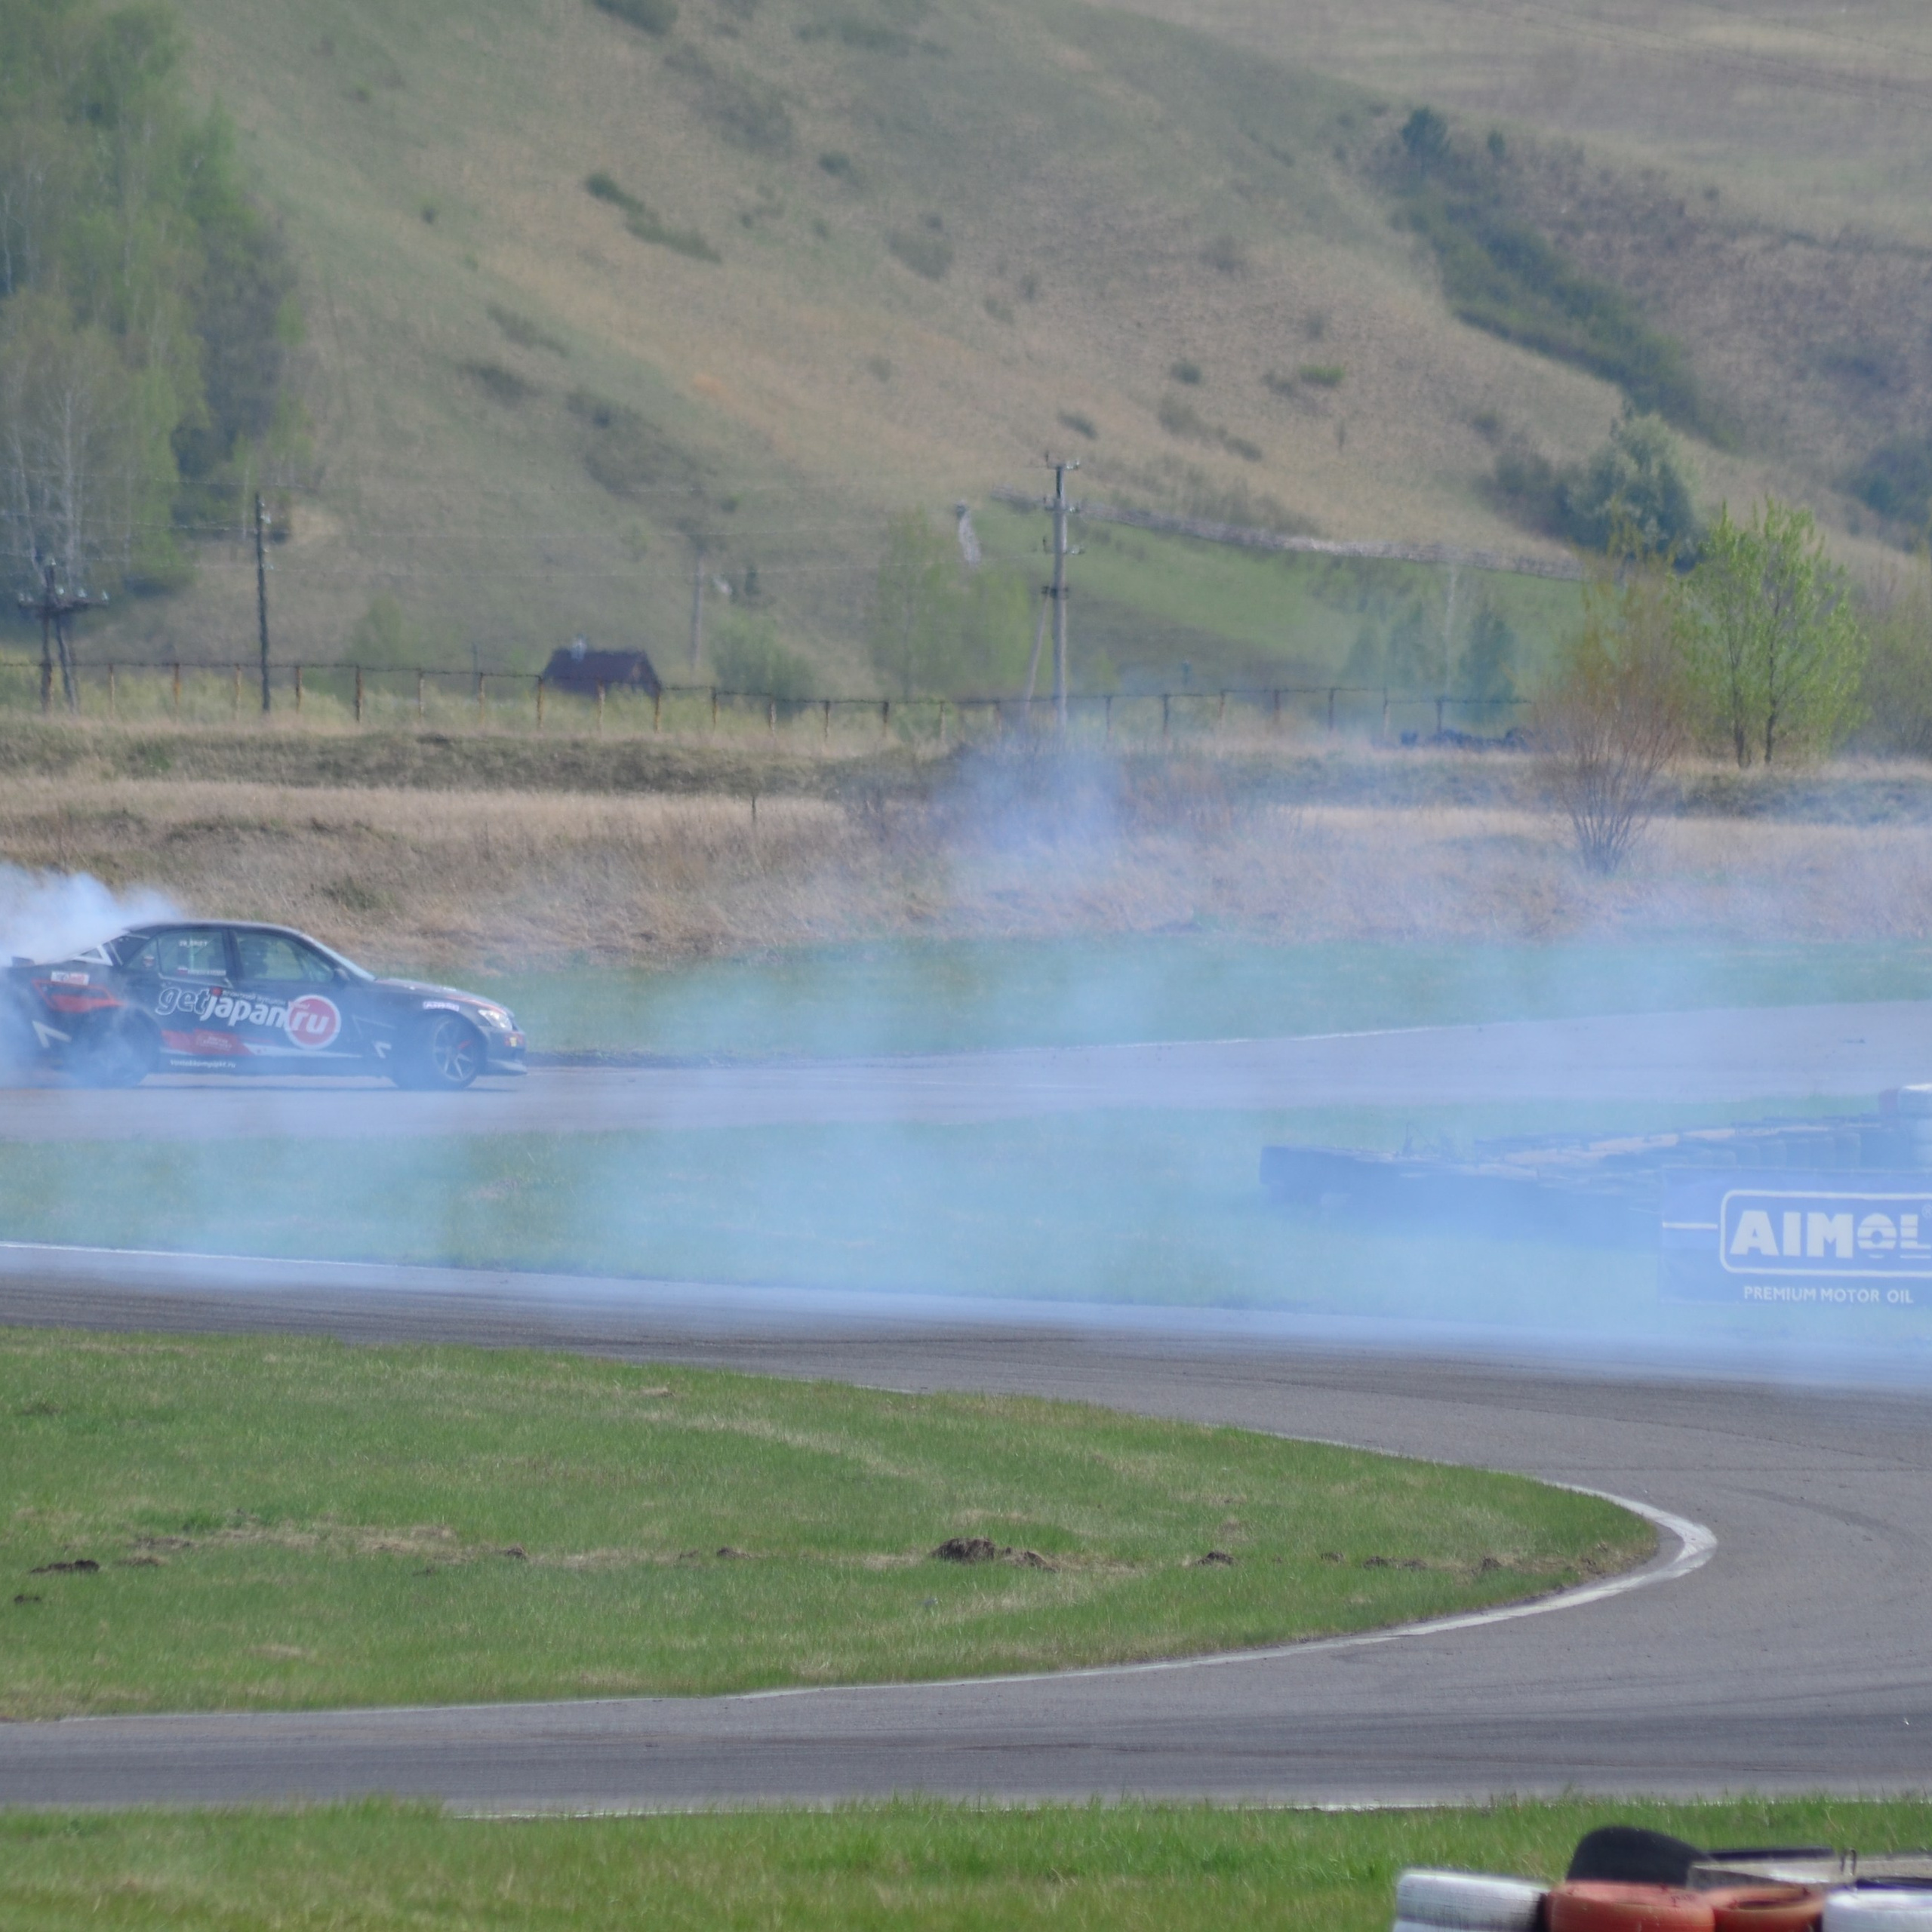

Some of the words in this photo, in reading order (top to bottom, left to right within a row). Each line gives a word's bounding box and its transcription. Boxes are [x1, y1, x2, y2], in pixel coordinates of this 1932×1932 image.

[1730, 1210, 1932, 1259] AIMOL
[1743, 1285, 1817, 1302] PREMIUM
[1820, 1287, 1880, 1303] MOTOR
[1887, 1289, 1915, 1305] OIL
